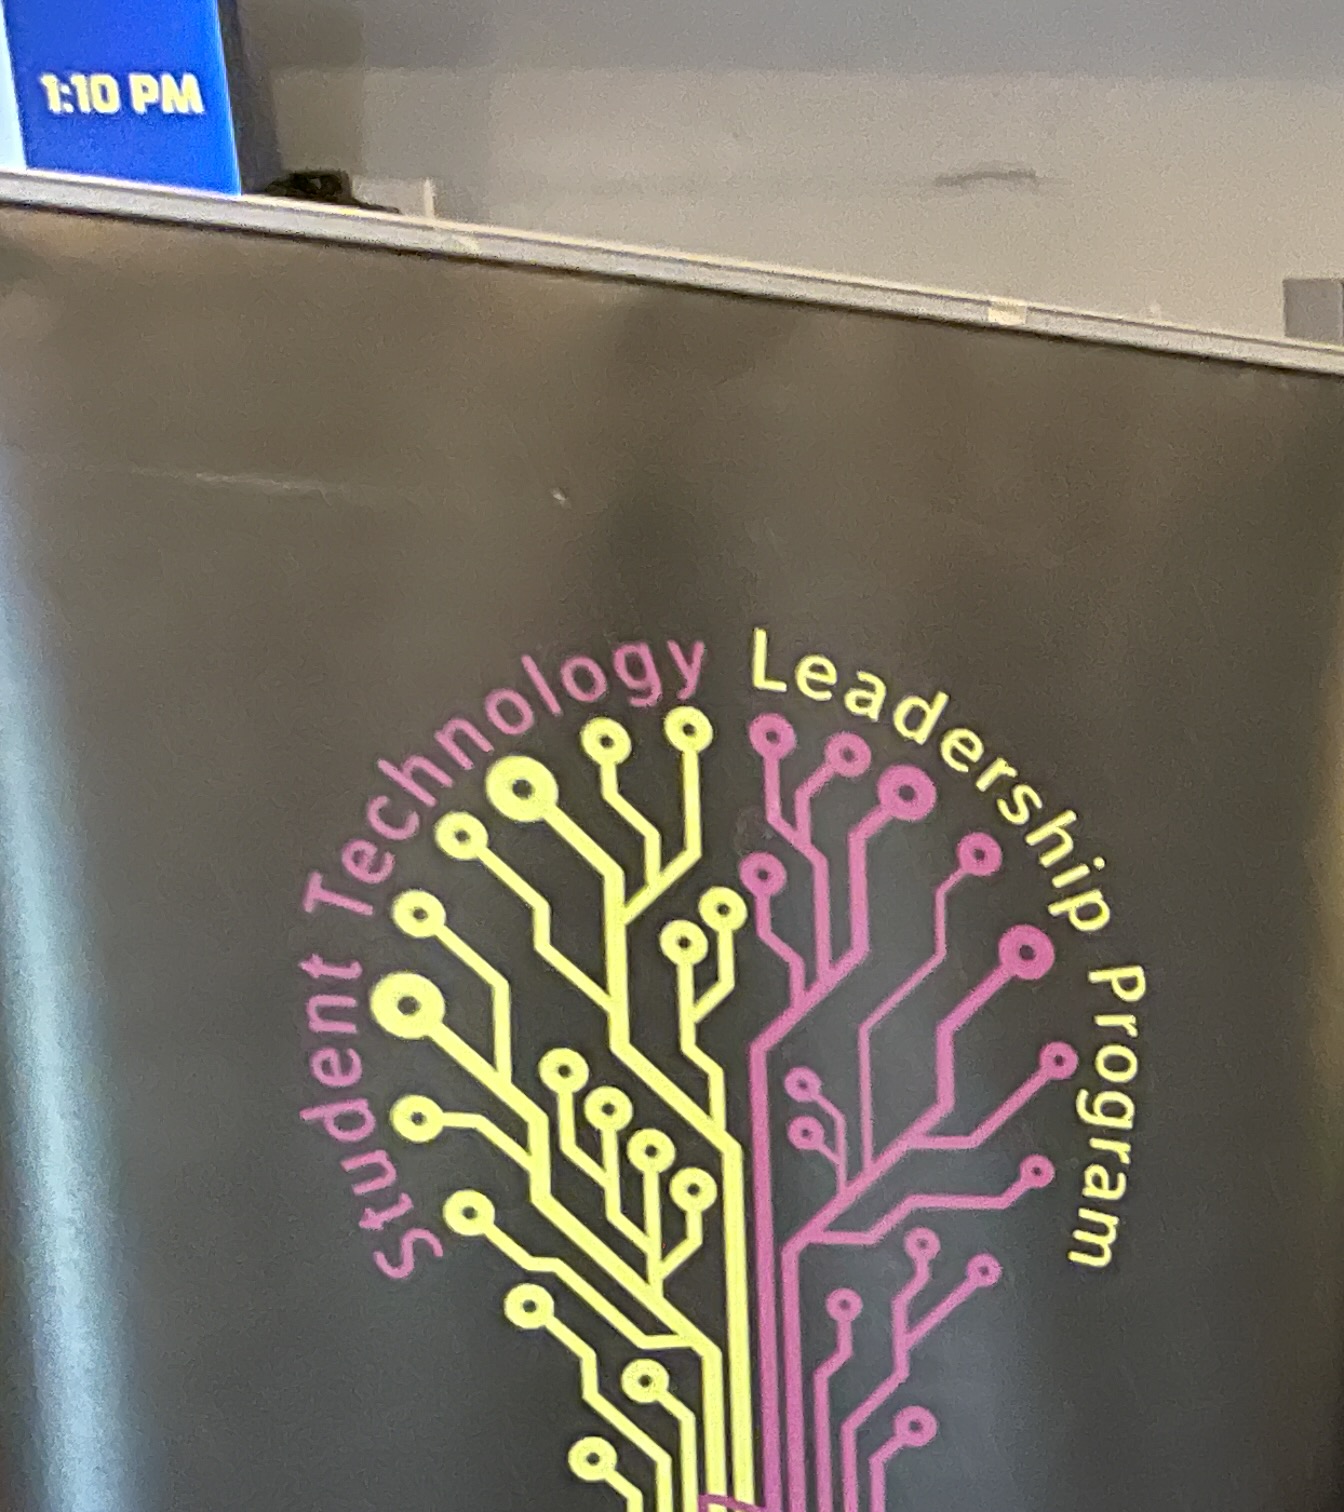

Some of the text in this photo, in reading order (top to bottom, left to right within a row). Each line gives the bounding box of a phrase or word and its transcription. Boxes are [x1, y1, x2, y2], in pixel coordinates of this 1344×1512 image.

[40, 72, 205, 116] 1:10 PM
[299, 627, 1147, 1280] Student Technology Leadership Program
